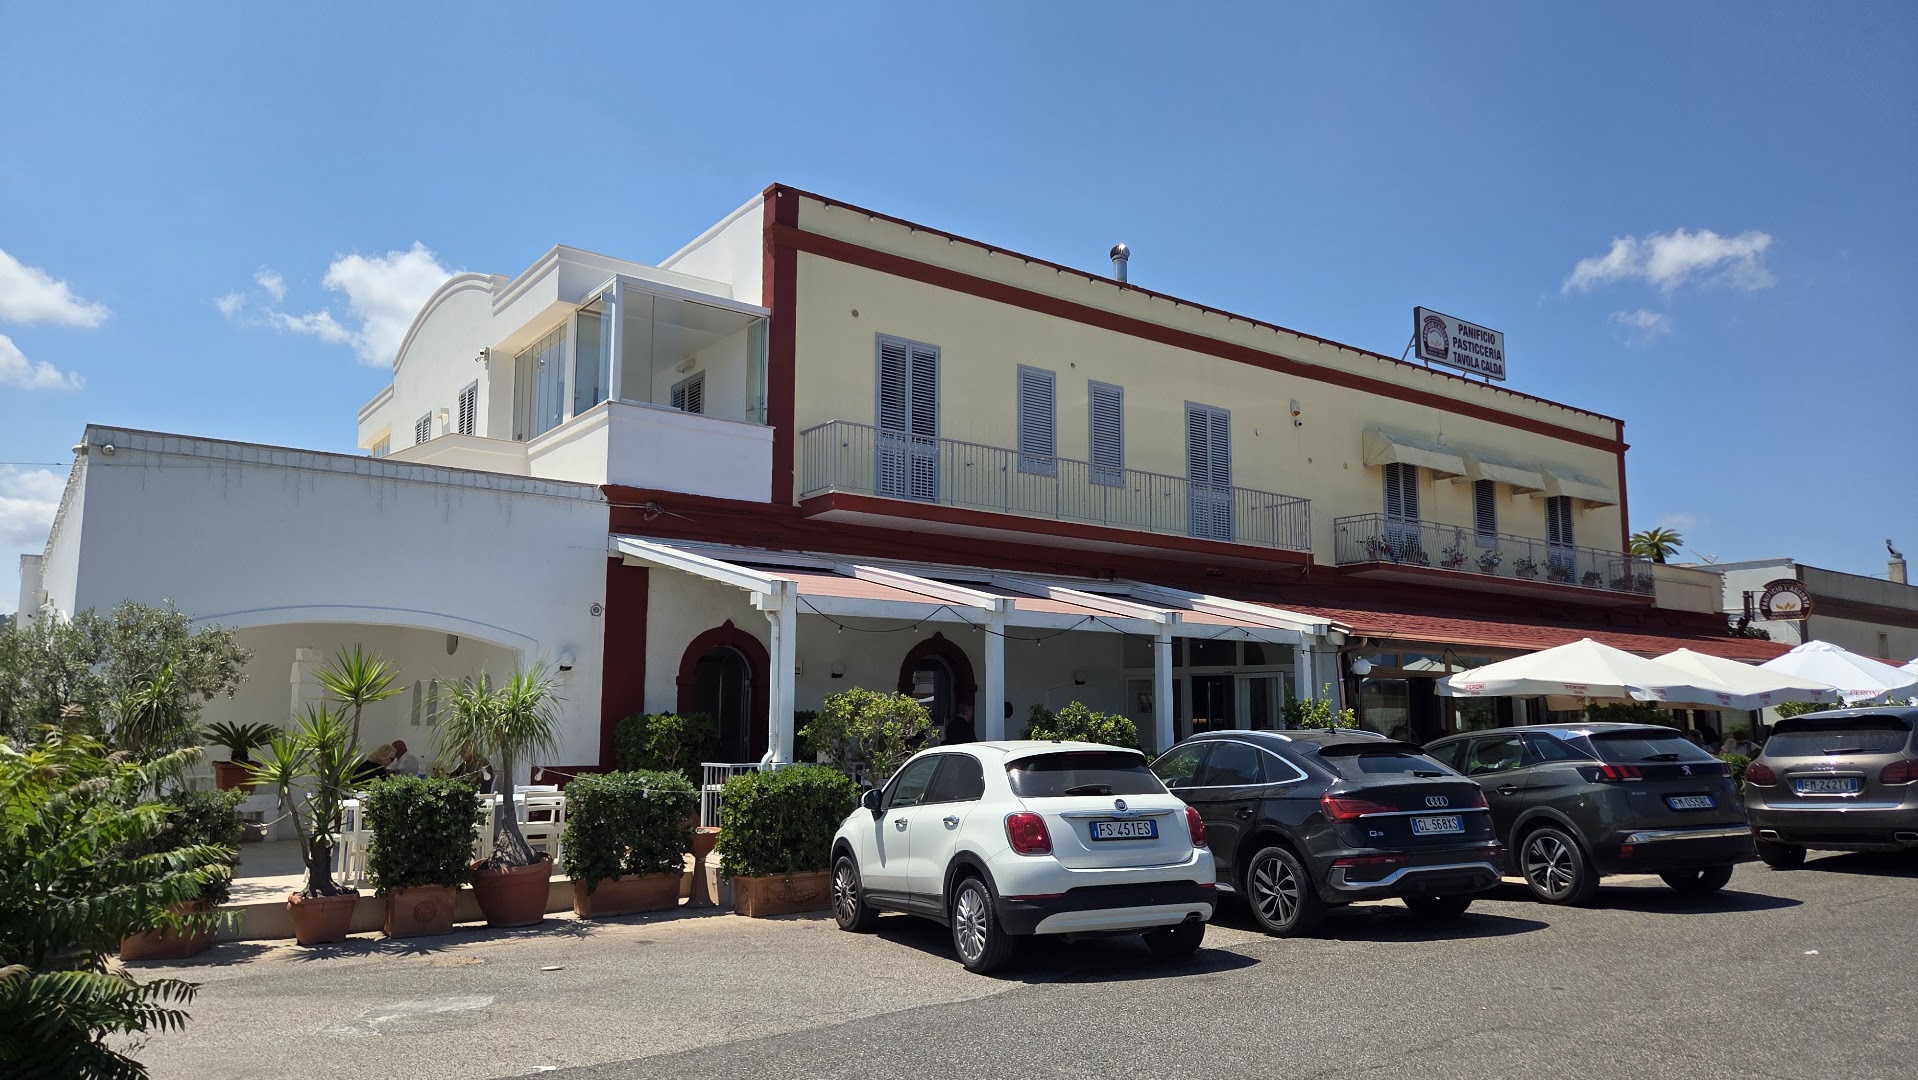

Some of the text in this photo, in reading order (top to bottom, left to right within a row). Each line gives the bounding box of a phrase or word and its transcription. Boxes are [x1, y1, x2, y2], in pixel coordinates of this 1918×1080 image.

[1458, 323, 1496, 345] PANIFICIO
[1452, 336, 1502, 361] PASTICCERIA
[1453, 351, 1480, 370] TAVOLA
[1481, 359, 1503, 376] CALDA
[1762, 585, 1783, 610] PANIFICIO
